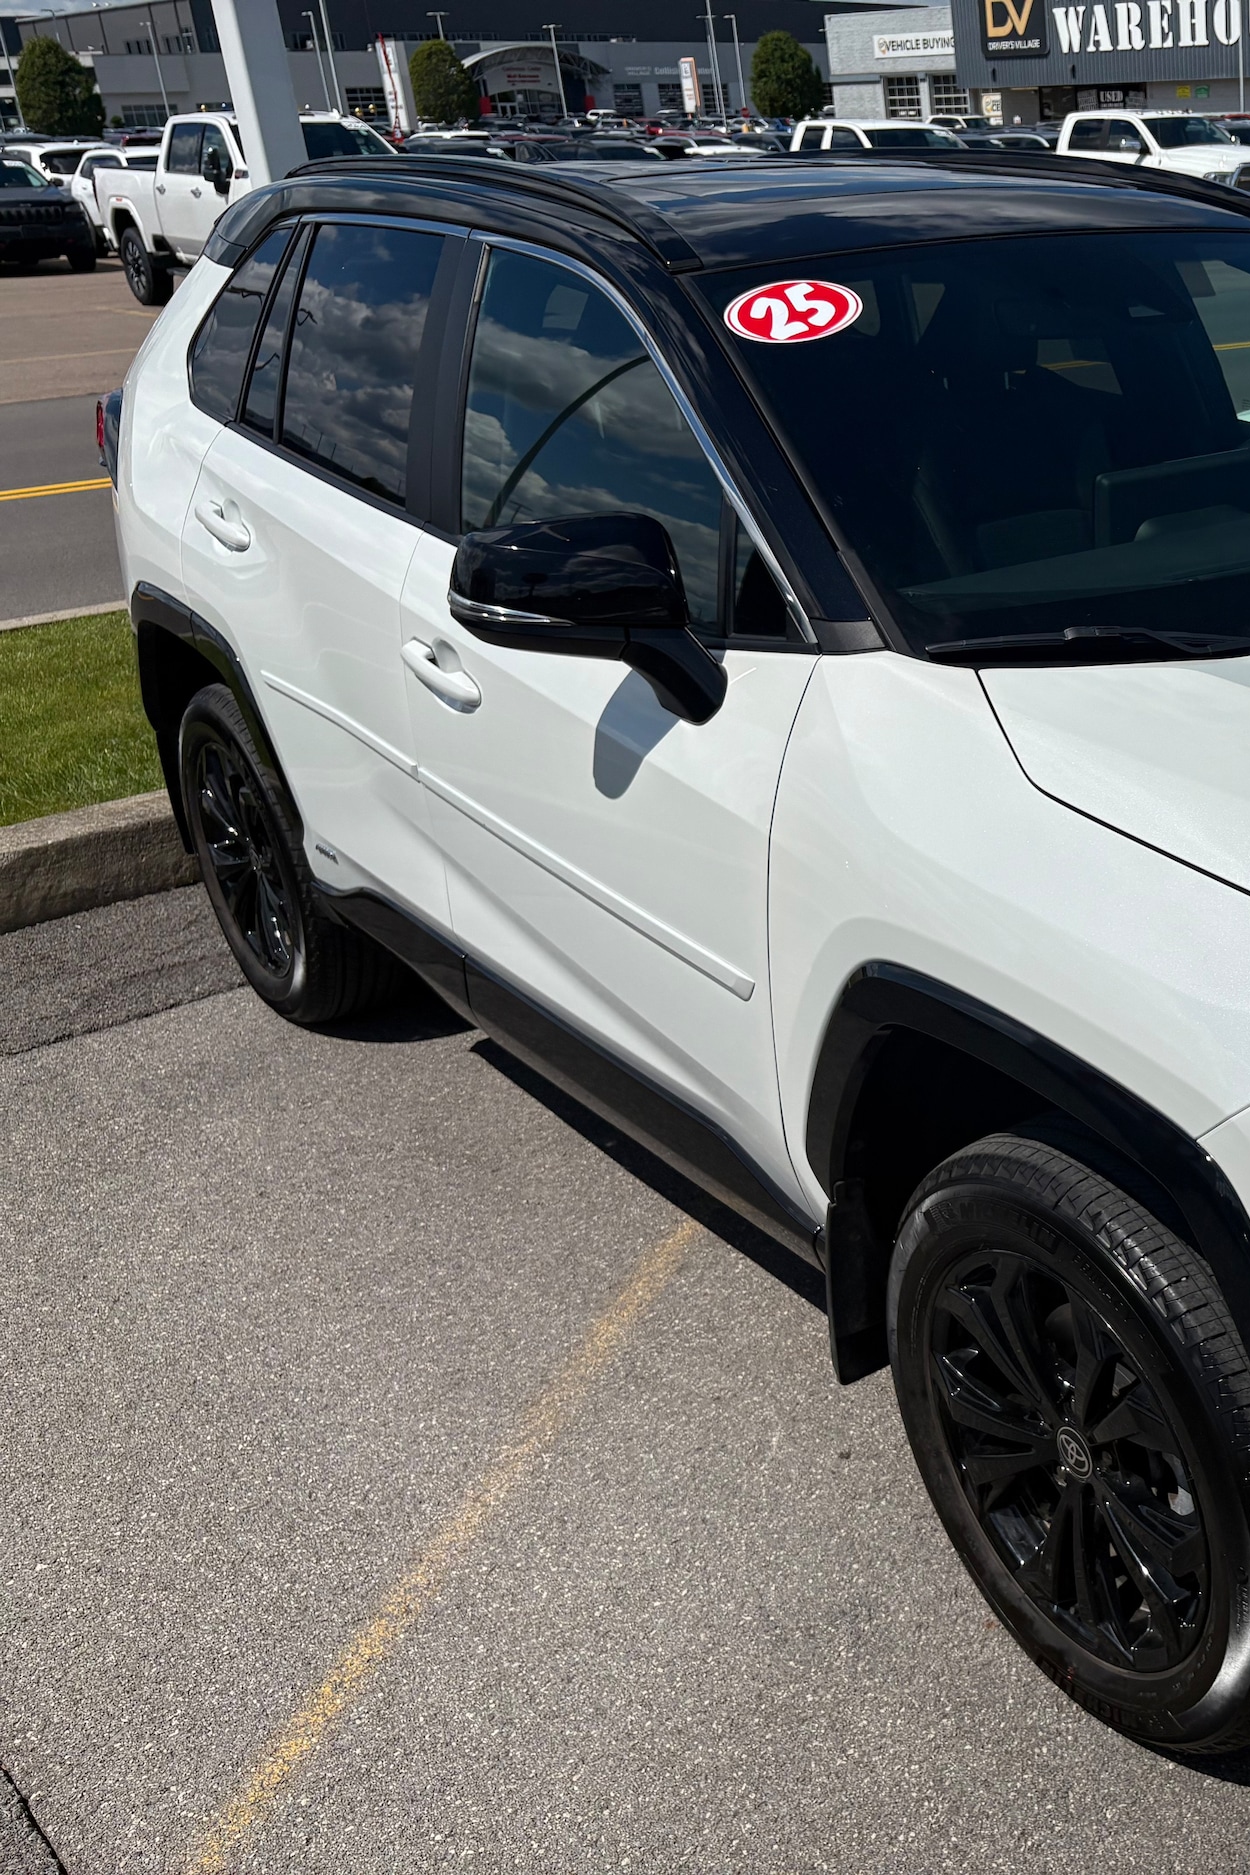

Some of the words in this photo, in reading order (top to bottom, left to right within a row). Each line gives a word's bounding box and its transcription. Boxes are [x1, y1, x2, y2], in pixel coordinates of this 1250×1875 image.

[886, 38, 921, 51] VEHICLE
[1015, 39, 1041, 49] VILLAGE
[1100, 90, 1123, 102] USED
[750, 283, 836, 340] 25
